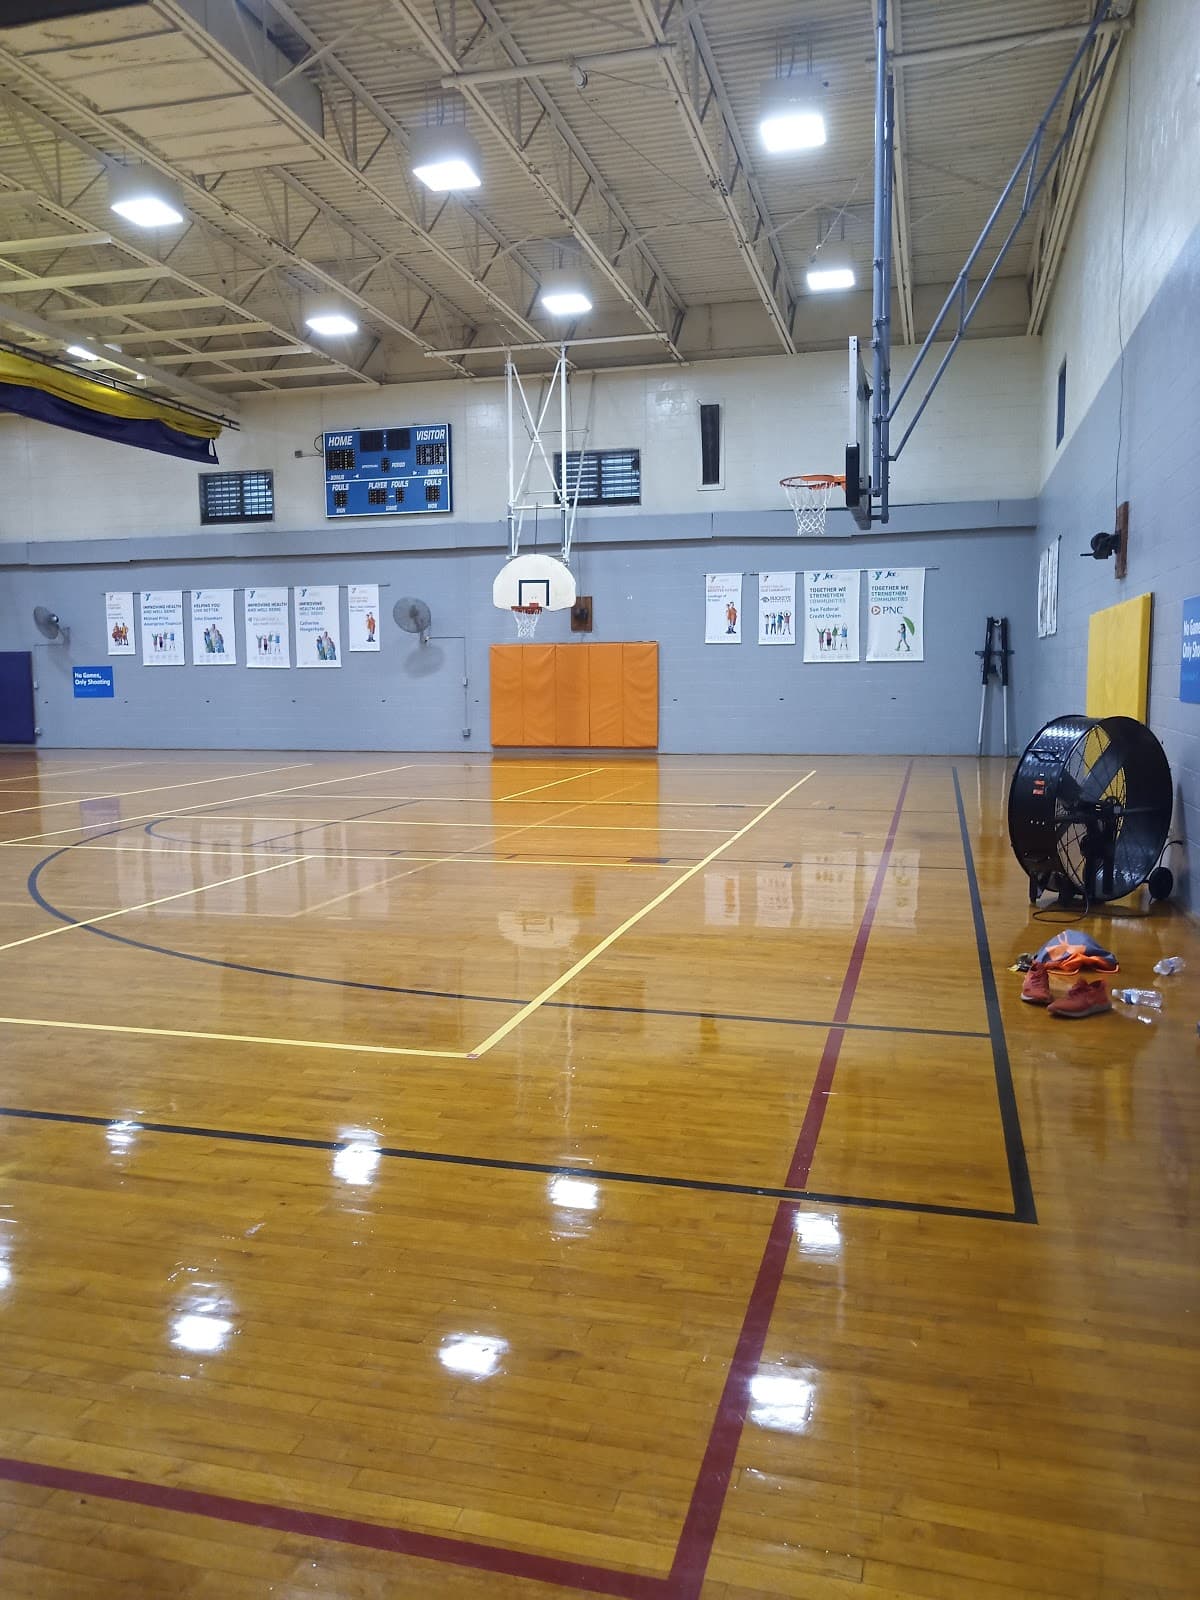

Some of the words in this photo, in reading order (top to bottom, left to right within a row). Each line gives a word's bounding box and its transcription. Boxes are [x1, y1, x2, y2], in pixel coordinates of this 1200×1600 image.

[416, 429, 446, 441] VISITOR
[328, 435, 353, 447] HOME
[331, 483, 350, 491] FOULS
[368, 481, 388, 490] PLAYER
[391, 480, 409, 488] FOULS
[423, 478, 442, 487] FOULS
[882, 606, 904, 615] PNC
[1183, 620, 1190, 637] No
[1182, 642, 1192, 663] Only
